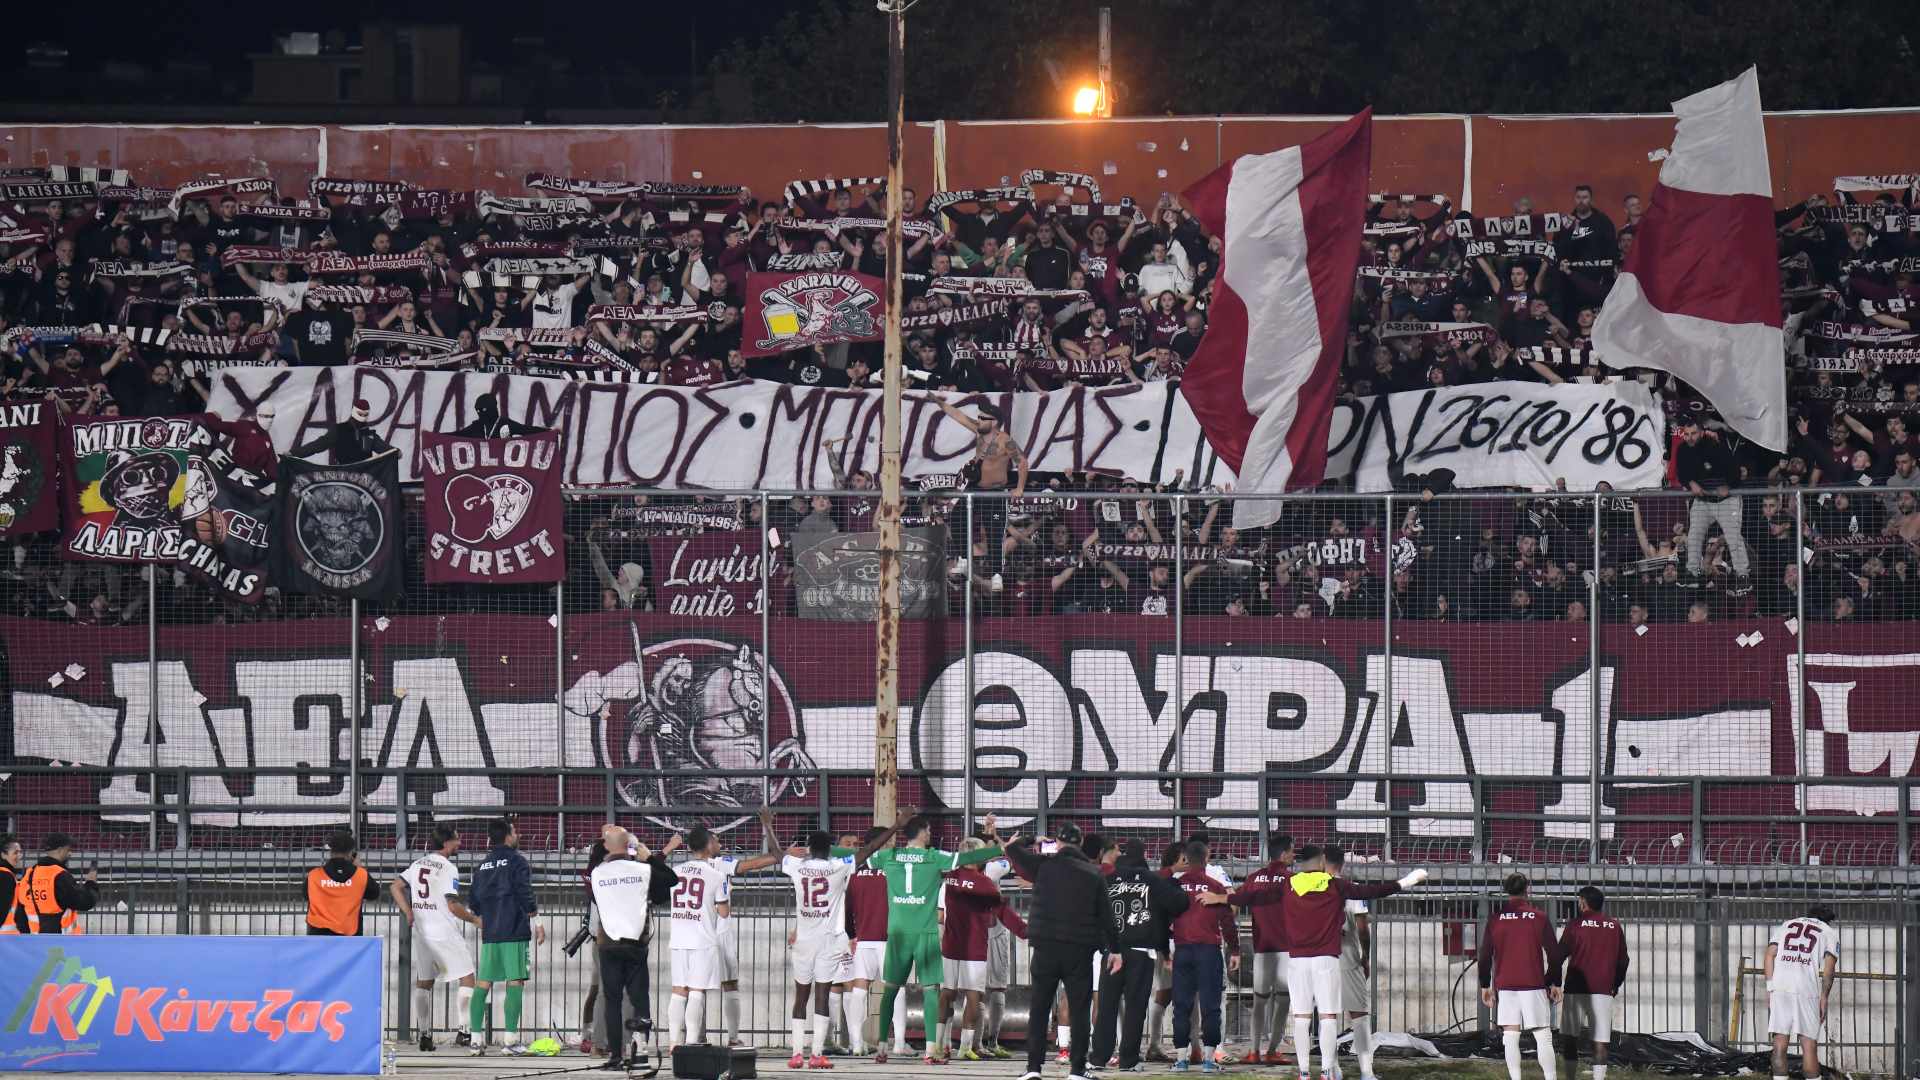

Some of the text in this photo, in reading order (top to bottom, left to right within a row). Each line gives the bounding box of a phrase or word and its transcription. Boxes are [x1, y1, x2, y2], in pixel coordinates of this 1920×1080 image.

[7, 182, 73, 199] LARISSA
[254, 207, 313, 218] ΛΑΡΙΣΑ FC
[321, 256, 356, 271] ΑΕΛ
[780, 272, 862, 296] XARAVGI
[603, 305, 638, 321] ΑΕΛ
[955, 341, 1046, 350] LRISSA
[423, 439, 556, 476] VOLOU
[71, 521, 183, 560] ΛΑΡΙΣ
[428, 528, 556, 576] STREET
[99, 657, 506, 826] ΑΕΛ
[479, 859, 508, 871] AEL FC
[857, 869, 874, 877] AEL
[417, 867, 431, 899] 5
[598, 876, 643, 887] CLUB MEDIA
[904, 862, 914, 894] 1
[961, 880, 975, 889] FC
[1254, 874, 1270, 883] AEL
[672, 876, 705, 910] 29
[801, 876, 830, 908] 12
[1195, 884, 1209, 892] FC
[1499, 911, 1536, 921] AEL FC
[1581, 918, 1615, 929] AEL FC
[1783, 921, 1823, 954] 25
[113, 985, 353, 1042] Κάντζας
